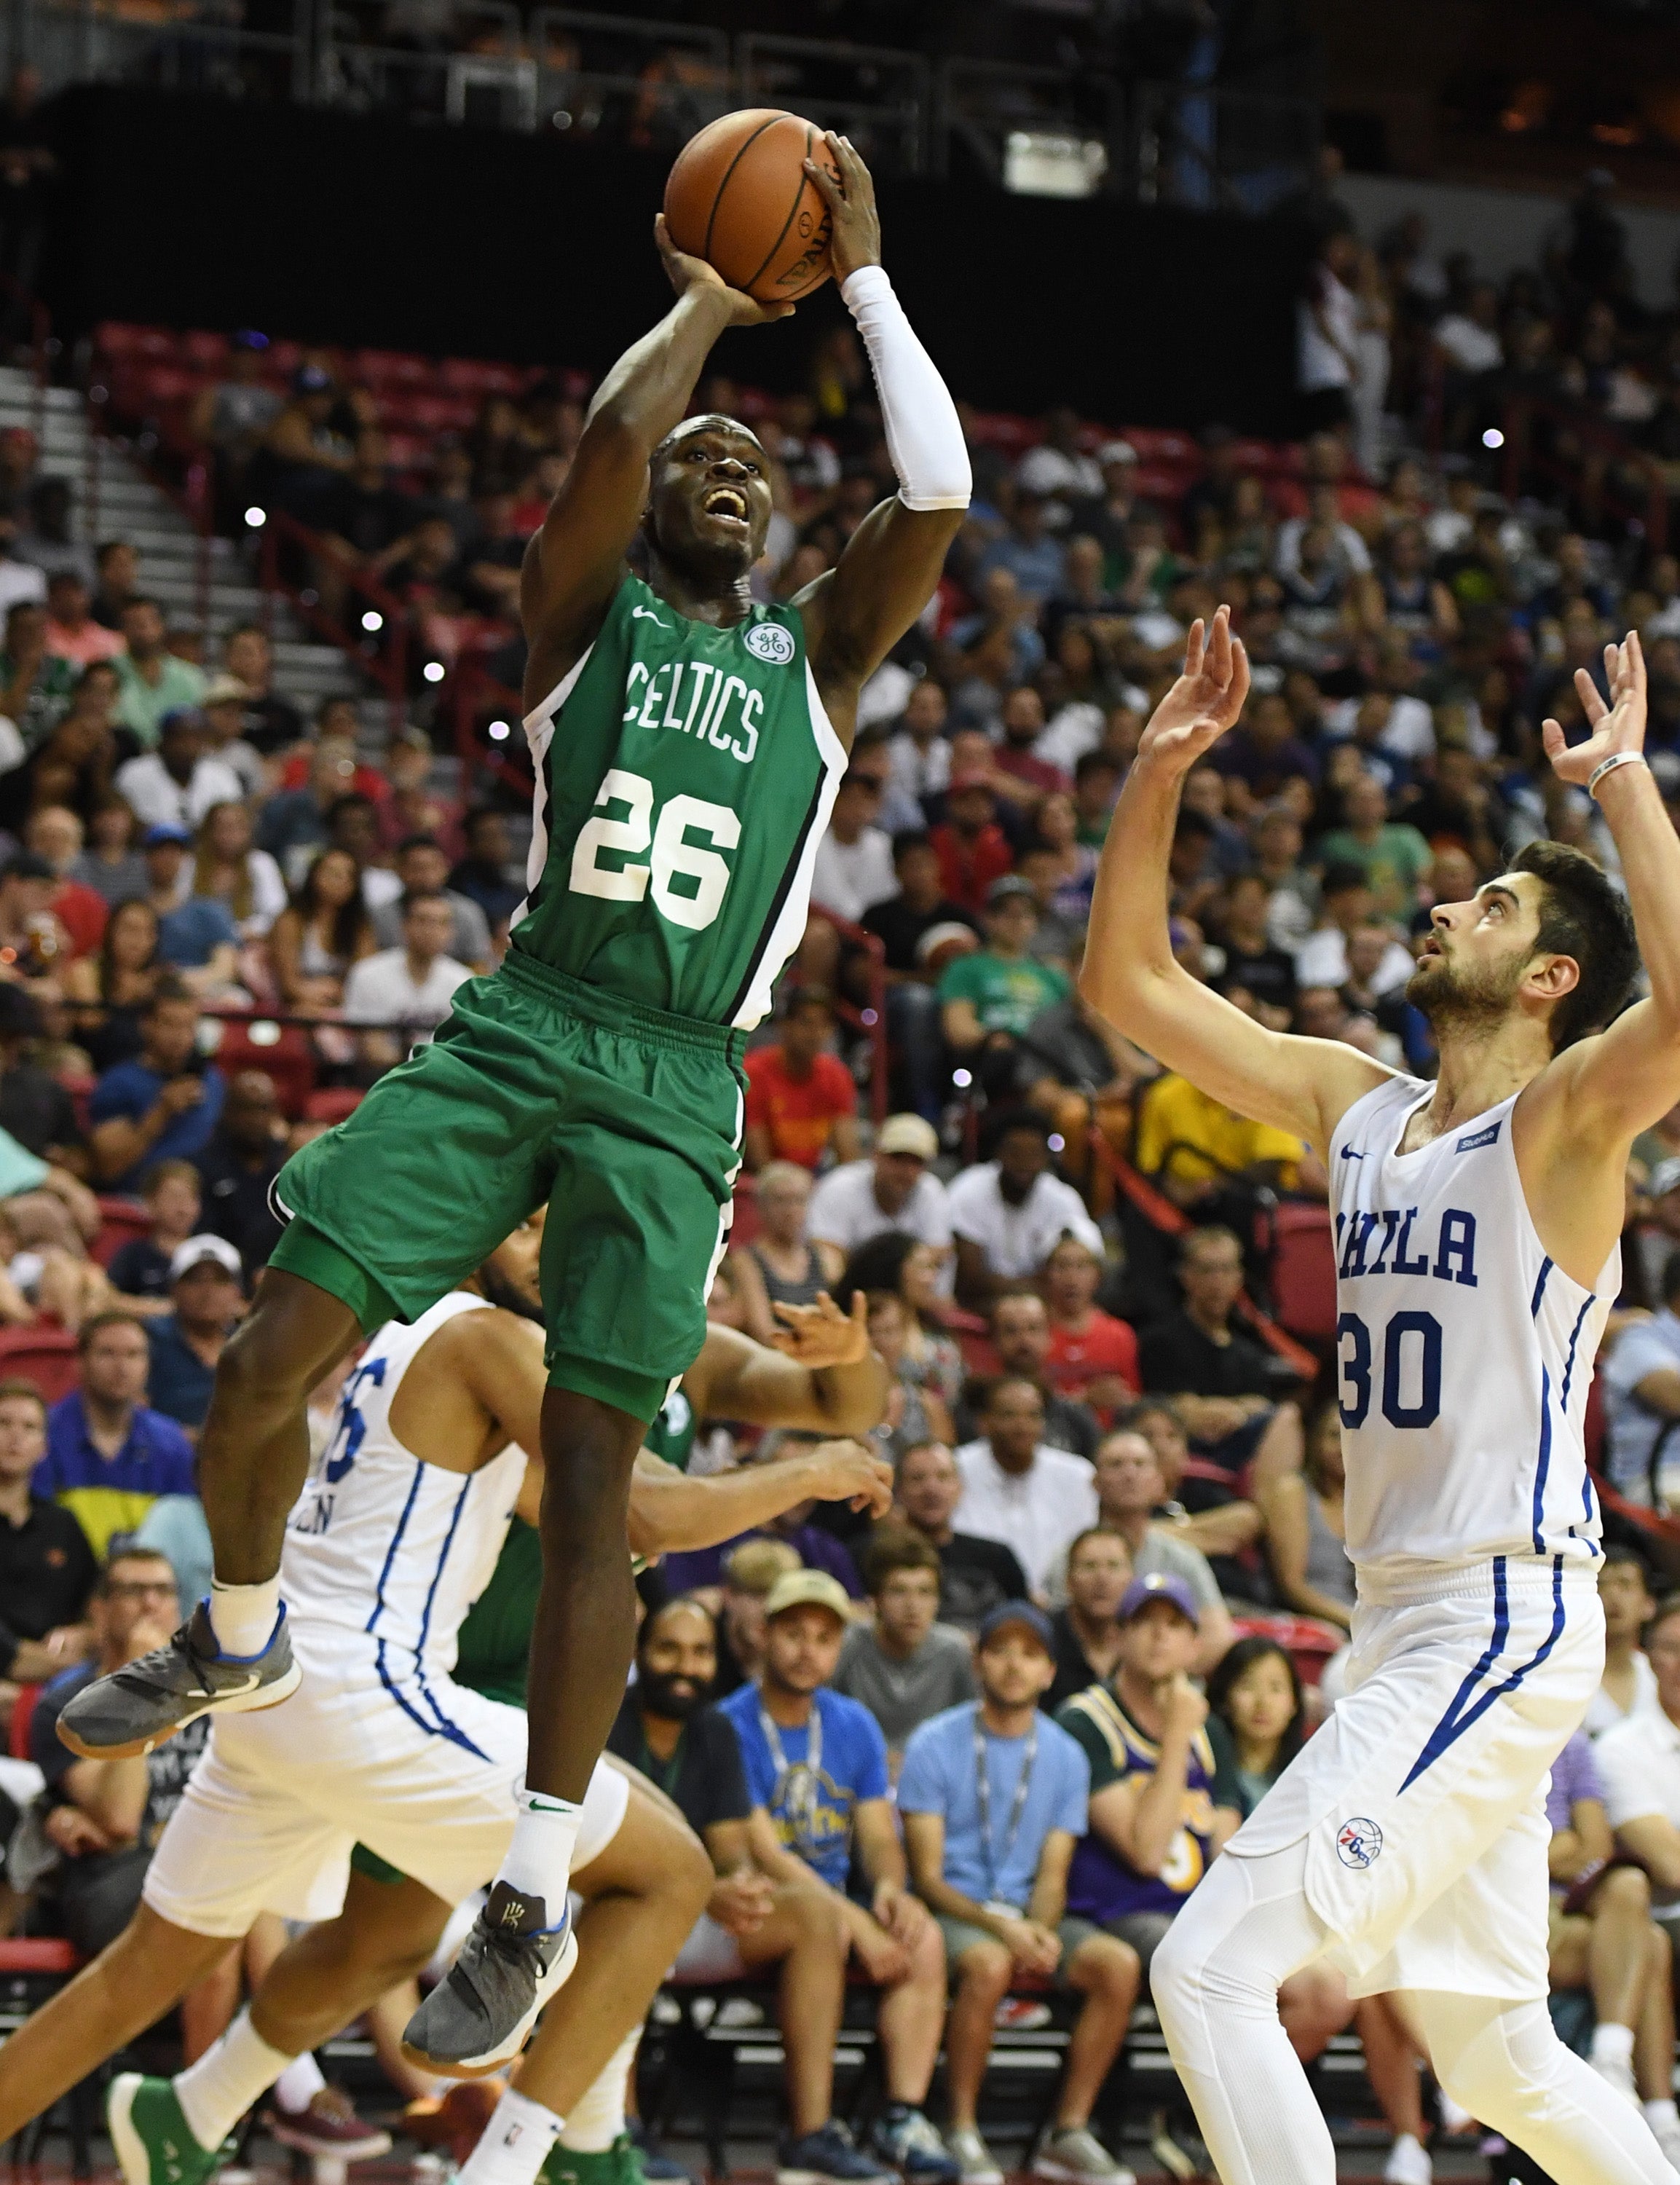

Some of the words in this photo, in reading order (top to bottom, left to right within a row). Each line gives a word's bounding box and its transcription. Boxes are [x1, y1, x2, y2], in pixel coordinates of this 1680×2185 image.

[623, 661, 765, 764] CELTICS
[569, 768, 742, 931] 26
[1336, 1311, 1443, 1430] 30
